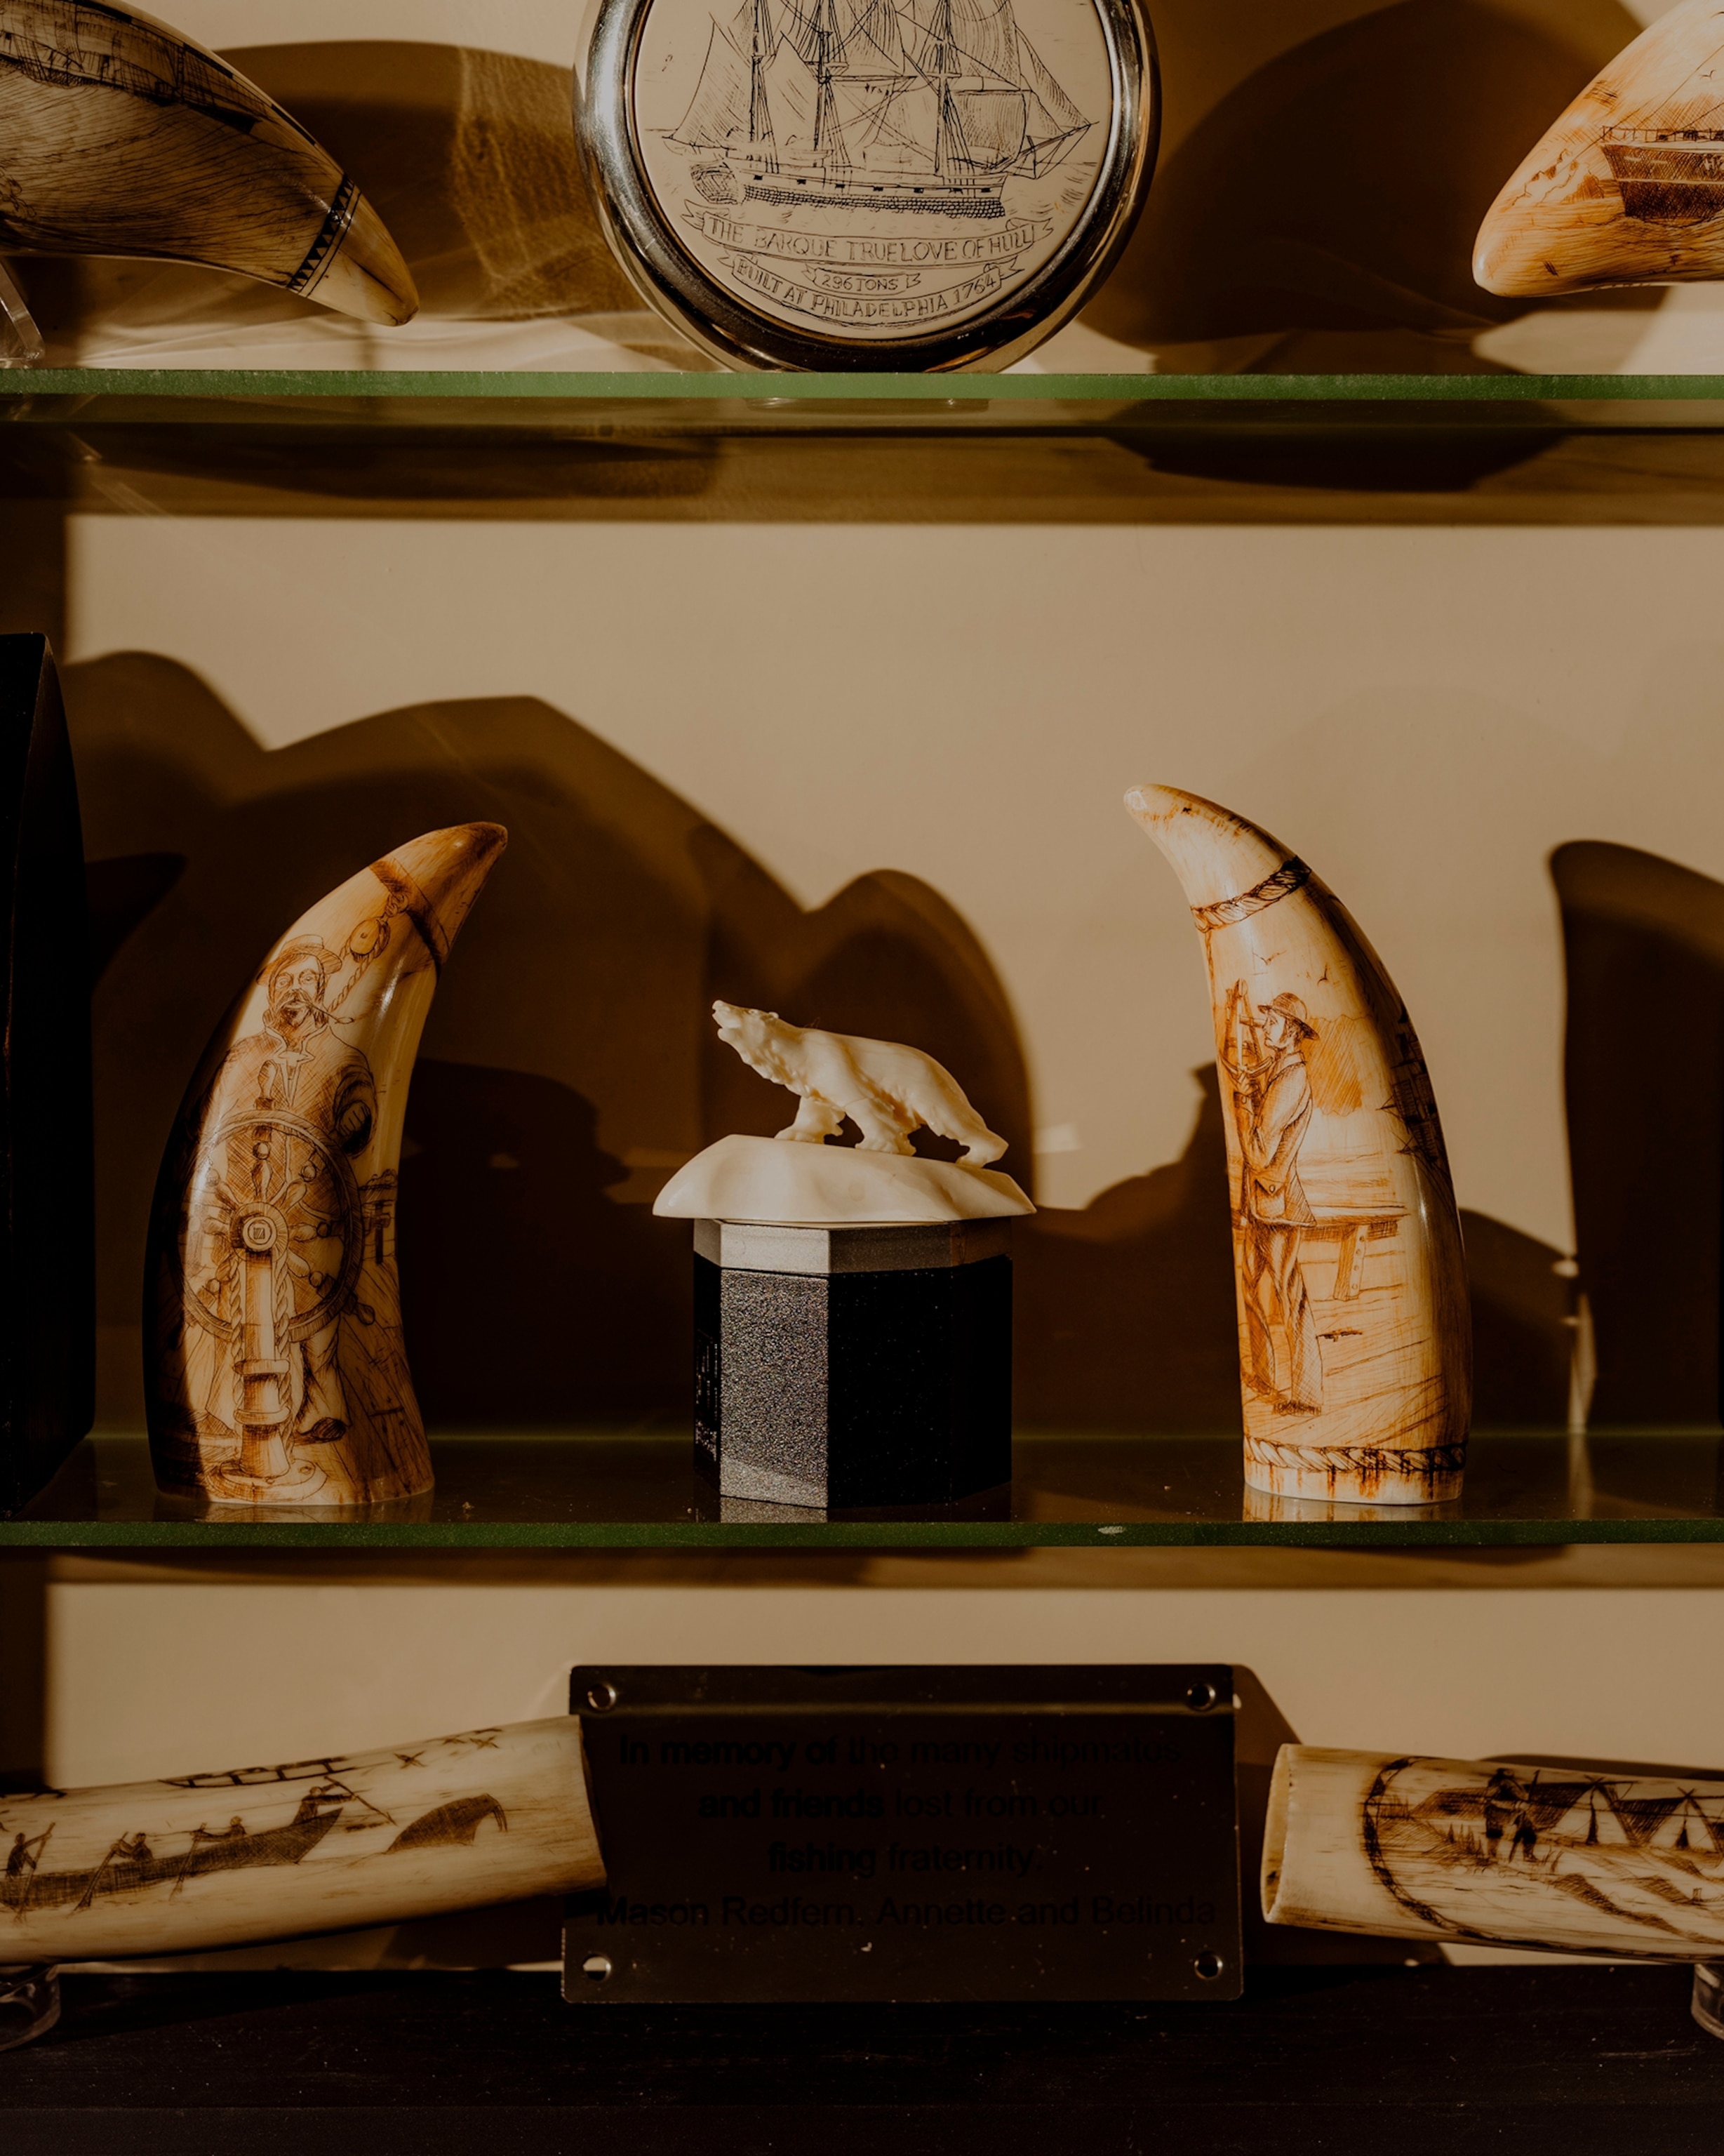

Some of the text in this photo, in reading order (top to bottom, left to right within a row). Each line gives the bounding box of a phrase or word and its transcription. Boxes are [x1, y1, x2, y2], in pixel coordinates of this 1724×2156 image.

[709, 217, 744, 244] THE
[755, 229, 836, 257] BARQUE
[963, 239, 986, 259] OF
[736, 258, 996, 317] BUILT AT PHILADELPHIA 1764
[821, 274, 898, 291] 296 TONS
[620, 1735, 1181, 1772] In memory of the many shipmates
[699, 1787, 1104, 1818] and friends lost from our
[768, 1842, 1043, 1878] fishing fraternity.
[597, 1896, 709, 1926] Mason
[876, 1898, 1005, 1926] Annette
[1017, 1896, 1078, 1925] and
[1092, 1896, 1216, 1925] Belinda
